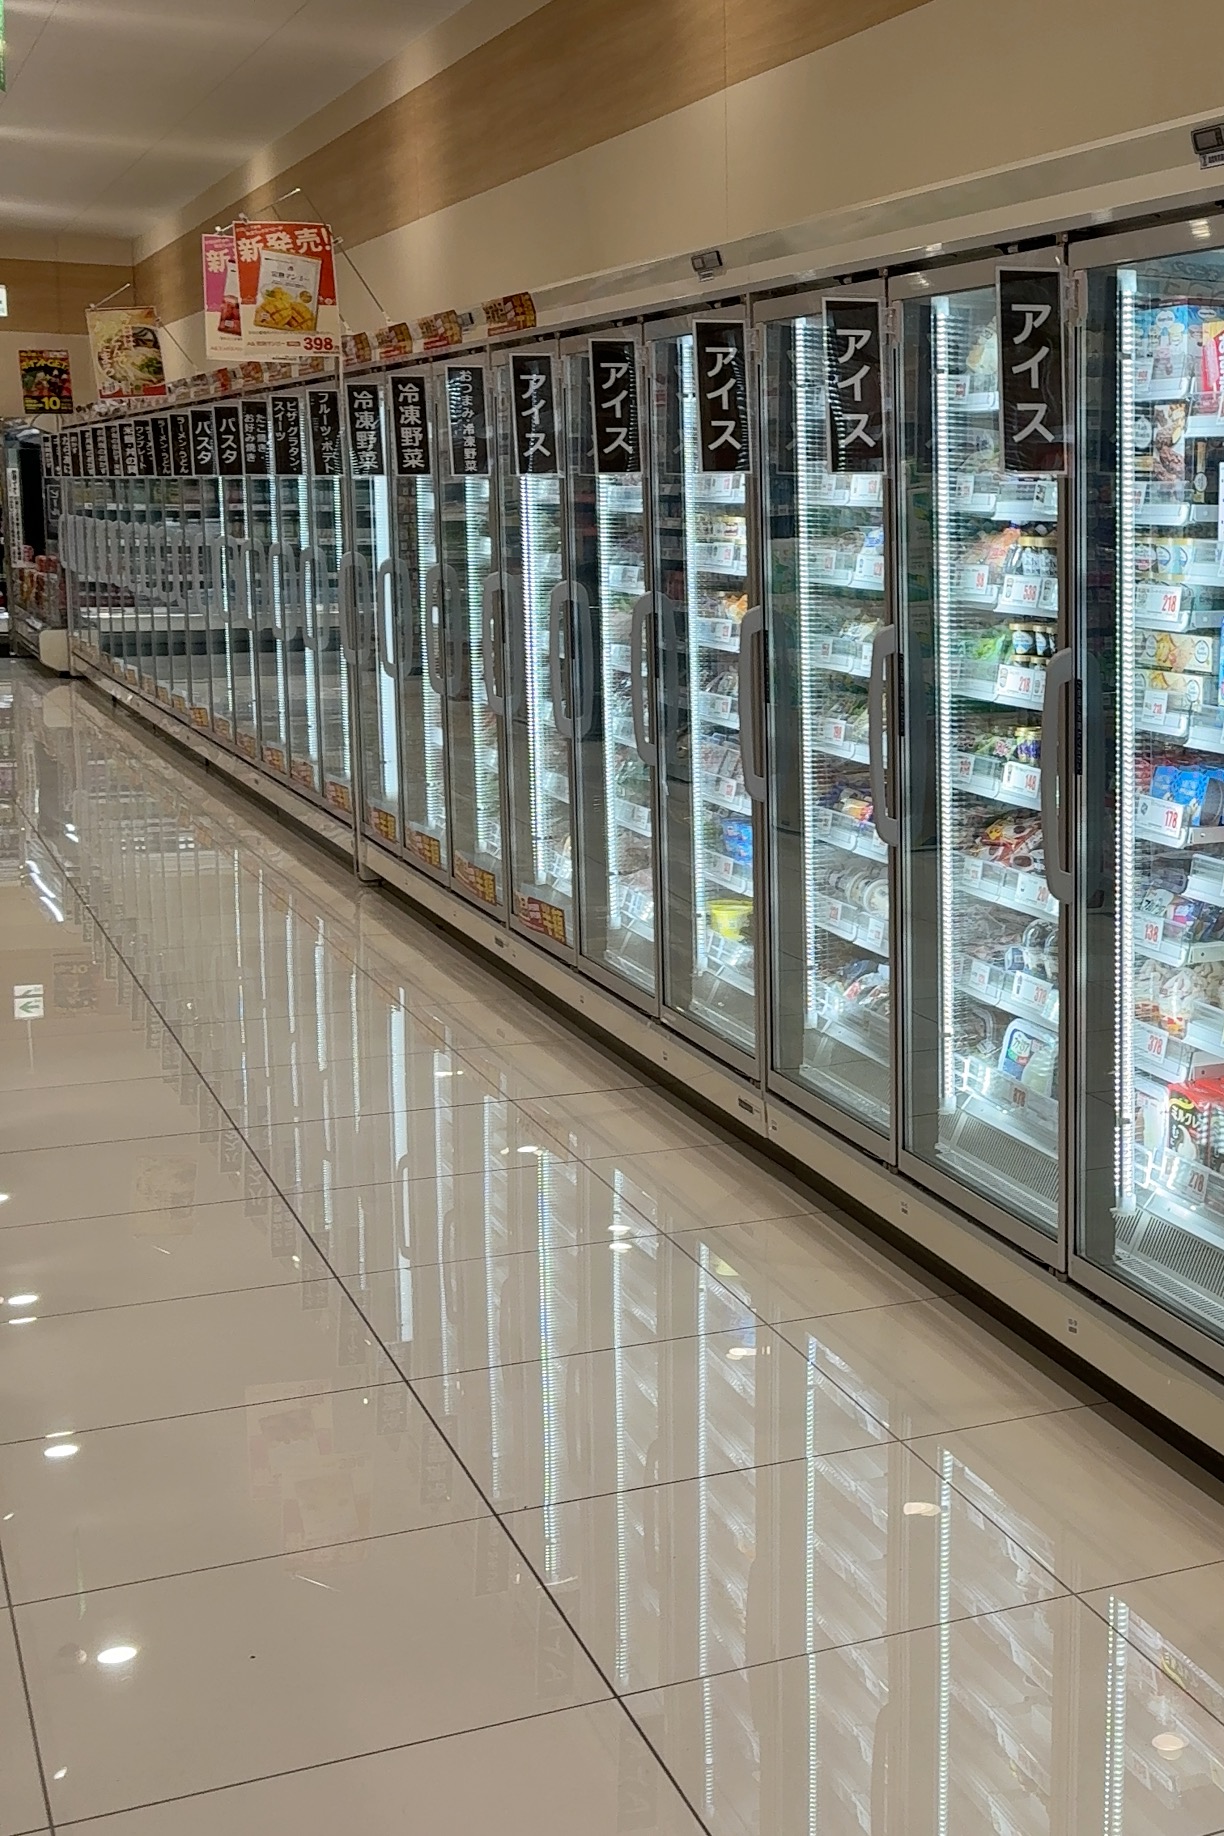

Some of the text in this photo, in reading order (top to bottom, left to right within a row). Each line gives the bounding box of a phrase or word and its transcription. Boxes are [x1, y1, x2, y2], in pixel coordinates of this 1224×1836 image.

[304, 337, 333, 351] 398
[1011, 304, 1055, 443] アイス
[274, 402, 286, 441] スイーツ
[398, 383, 425, 469] 冷凍野菜
[459, 370, 477, 472] おつまみ・冷凍野菜
[520, 374, 550, 457] アイス
[600, 362, 633, 455] アイス
[705, 346, 741, 451] アイス
[836, 328, 876, 448] アイス
[195, 421, 213, 464] パスタ
[220, 418, 237, 464] パスタ
[318, 393, 334, 473] フルーツ・ポテト
[353, 390, 378, 470] 冷凍野菜
[1162, 594, 1177, 613] 218
[1165, 810, 1178, 829] 178
[1171, 1107, 1205, 1131] ミルクレ
